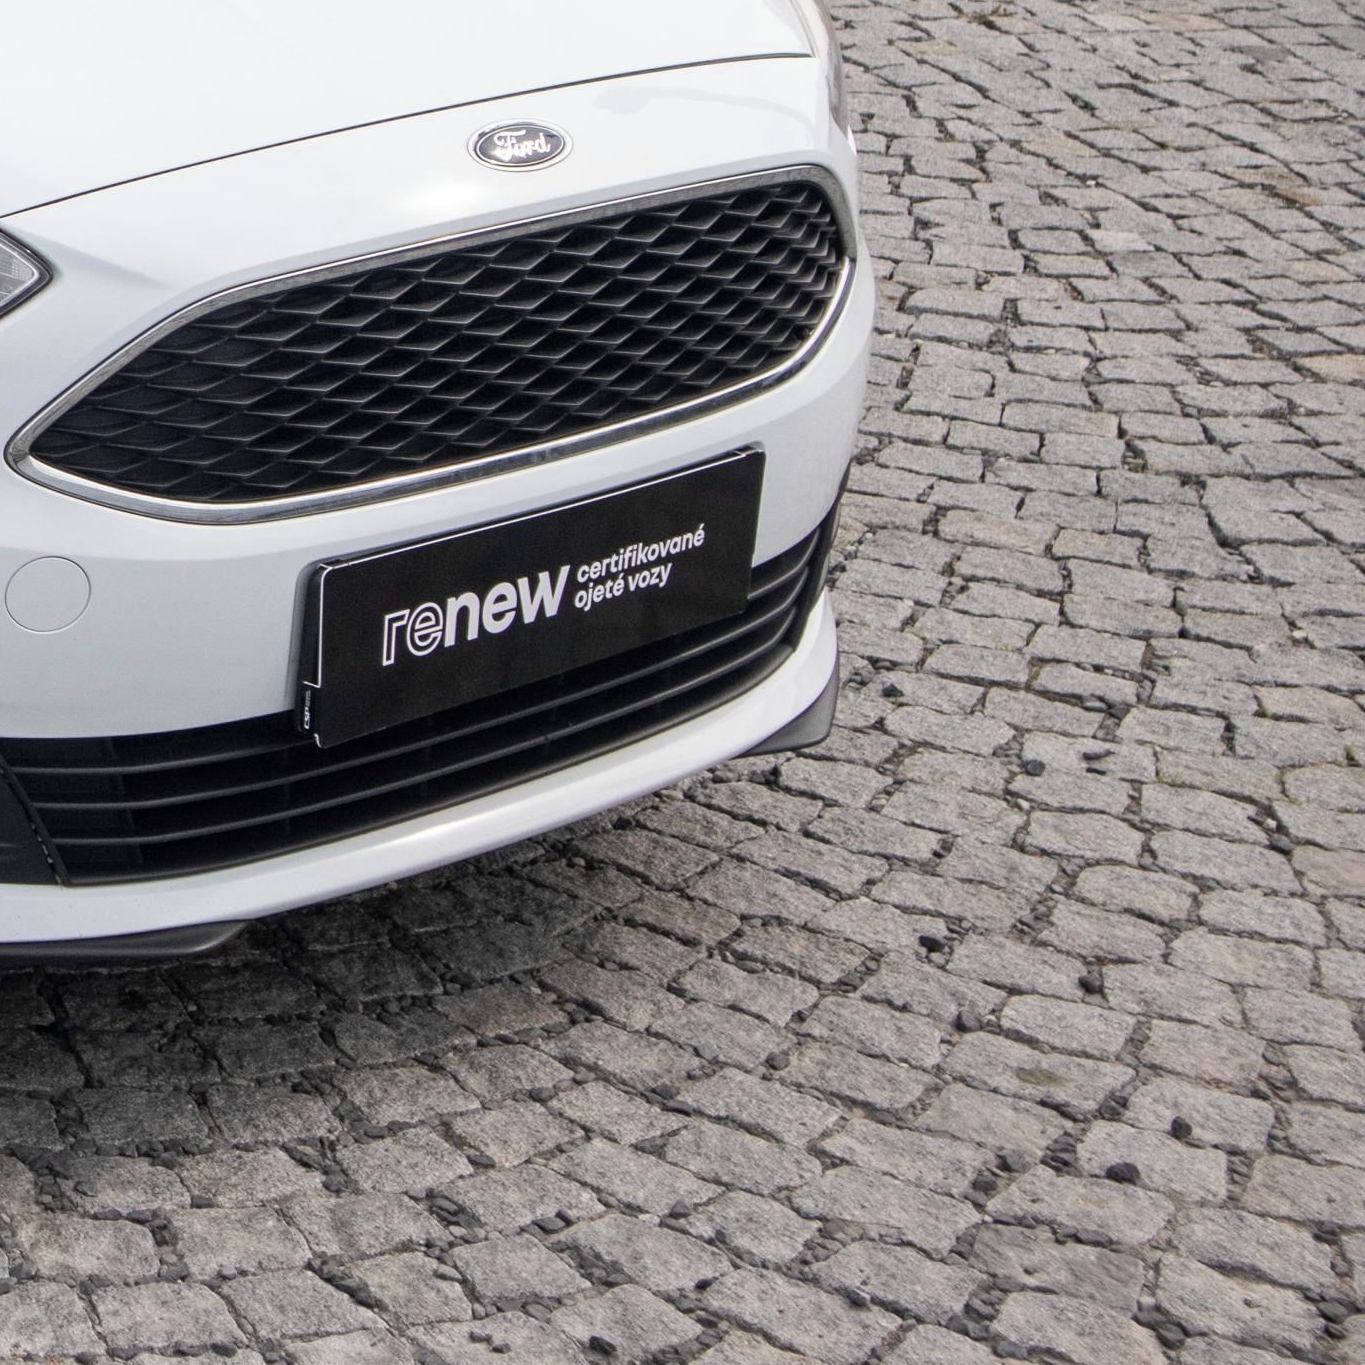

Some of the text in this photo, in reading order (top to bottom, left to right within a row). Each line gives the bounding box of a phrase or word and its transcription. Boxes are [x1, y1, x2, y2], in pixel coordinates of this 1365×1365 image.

[491, 129, 551, 162] Ford
[382, 523, 705, 667] renew certifikované
[574, 562, 673, 612] ojeté vozy
